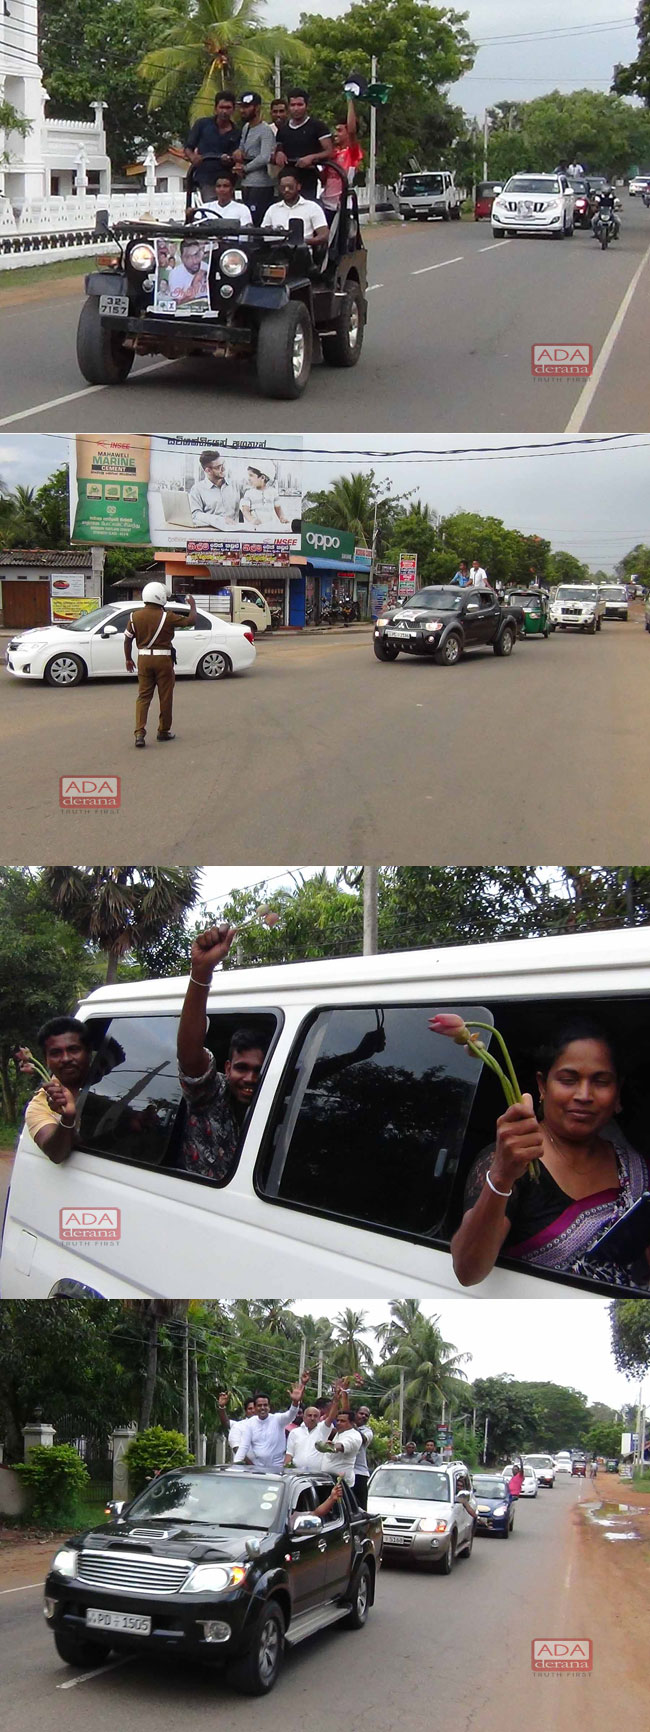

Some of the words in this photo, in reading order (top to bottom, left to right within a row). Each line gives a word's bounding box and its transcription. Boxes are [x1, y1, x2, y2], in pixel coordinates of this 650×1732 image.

[101, 305, 127, 314] 7157
[92, 456, 136, 467] MARINE
[274, 538, 298, 546] INSEE
